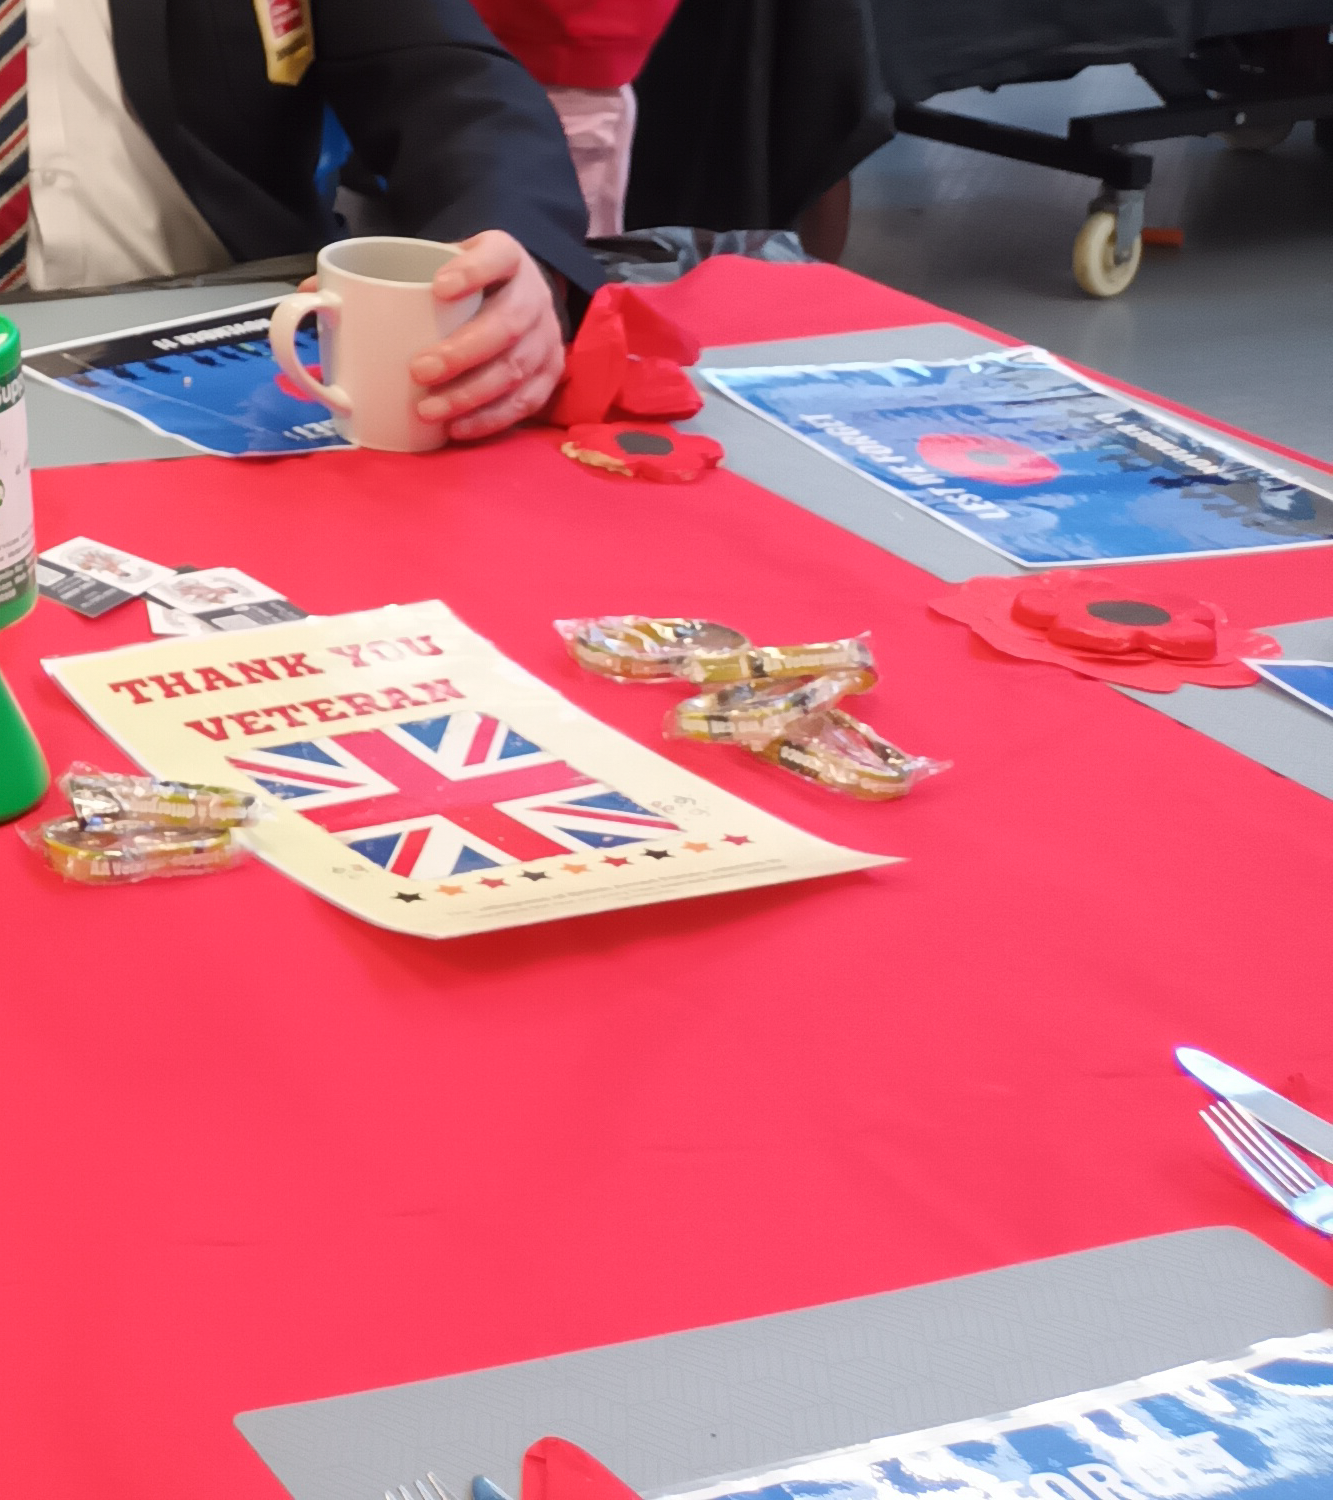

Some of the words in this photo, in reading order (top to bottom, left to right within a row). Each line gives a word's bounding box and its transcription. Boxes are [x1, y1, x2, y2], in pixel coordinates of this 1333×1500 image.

[108, 652, 326, 705] THANK
[328, 633, 446, 673] YOU
[183, 677, 467, 743] VETERAN
